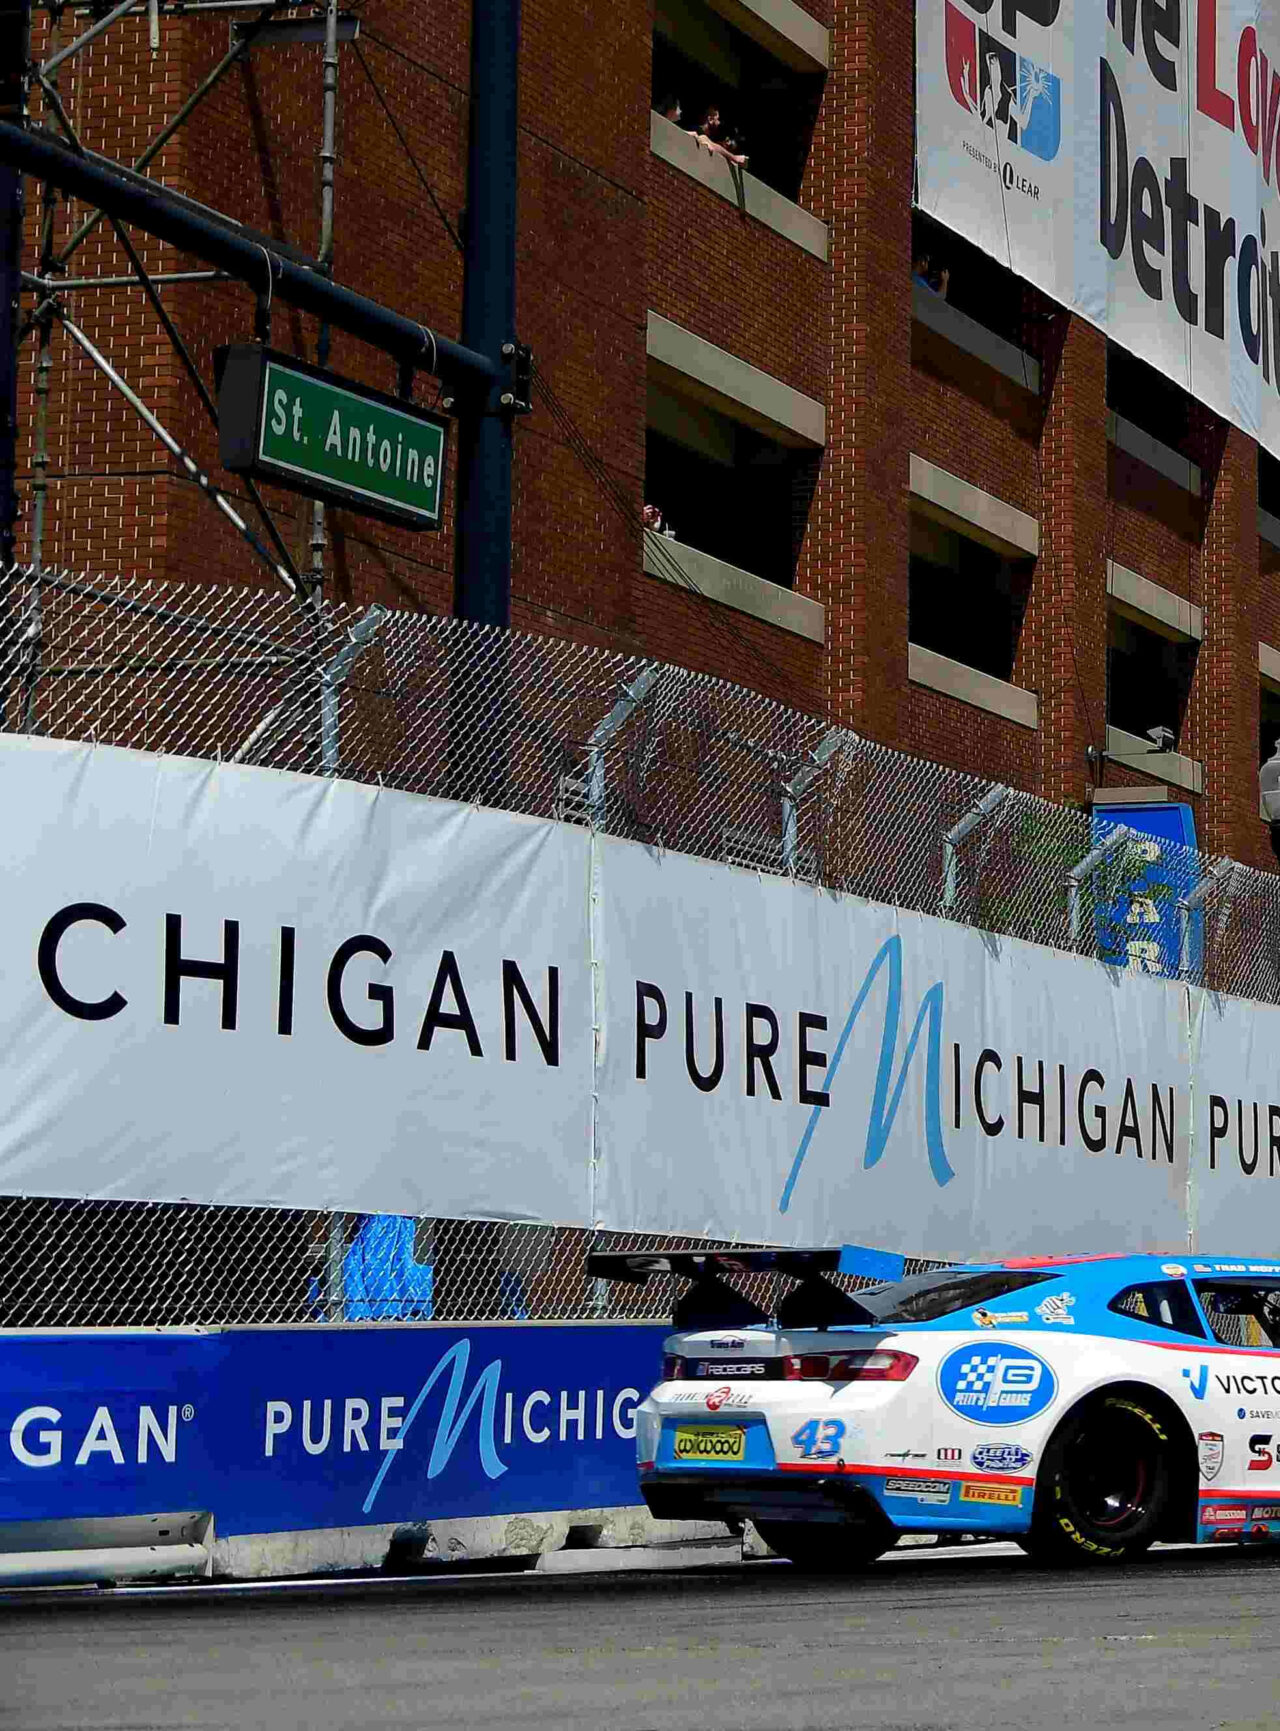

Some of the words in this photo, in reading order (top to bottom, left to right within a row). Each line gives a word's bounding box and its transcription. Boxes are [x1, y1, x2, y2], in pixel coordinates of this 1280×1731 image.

[1016, 175, 1041, 201] LEAR
[271, 388, 309, 446] St.
[324, 408, 436, 489] Antoine
[36, 902, 560, 1068] CHIGAN
[635, 979, 831, 1108] PURE
[778, 932, 1176, 1215] MICHIGAN
[264, 1396, 405, 1457] PURE
[790, 1418, 847, 1457] 43
